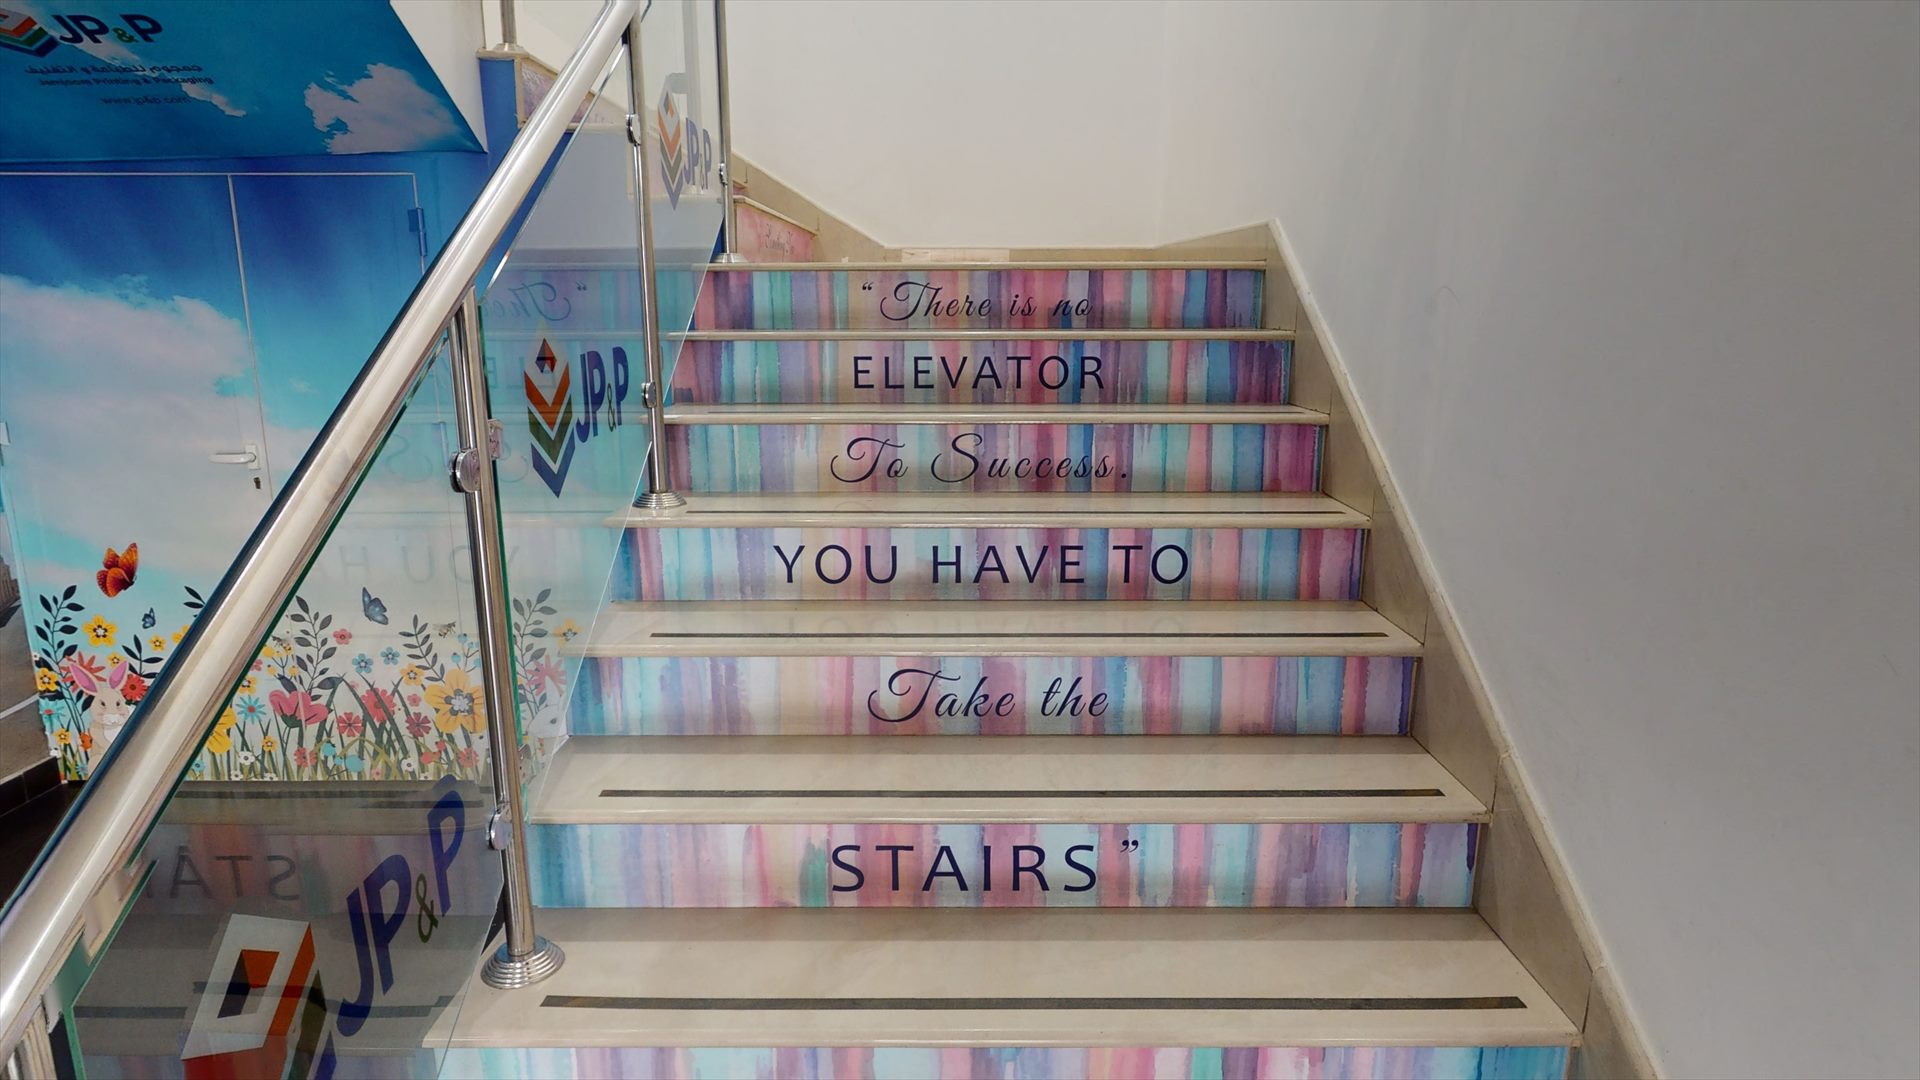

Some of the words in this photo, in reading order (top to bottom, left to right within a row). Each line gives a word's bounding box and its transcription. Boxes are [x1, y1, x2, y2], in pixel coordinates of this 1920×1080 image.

[51, 14, 163, 44] JP&P
[683, 117, 712, 190] JP&P
[1009, 293, 1036, 316] is
[1052, 295, 1094, 317] no
[575, 346, 629, 444] JP&P
[853, 356, 1104, 390] ELEVATOR
[830, 436, 908, 484] To
[930, 432, 1129, 484] Success.
[773, 544, 898, 585] YOU
[931, 544, 1086, 585] HAVE
[1112, 544, 1190, 585] TO
[867, 668, 1017, 724] Take
[1040, 676, 1109, 718] the
[336, 789, 465, 1038] JP&P
